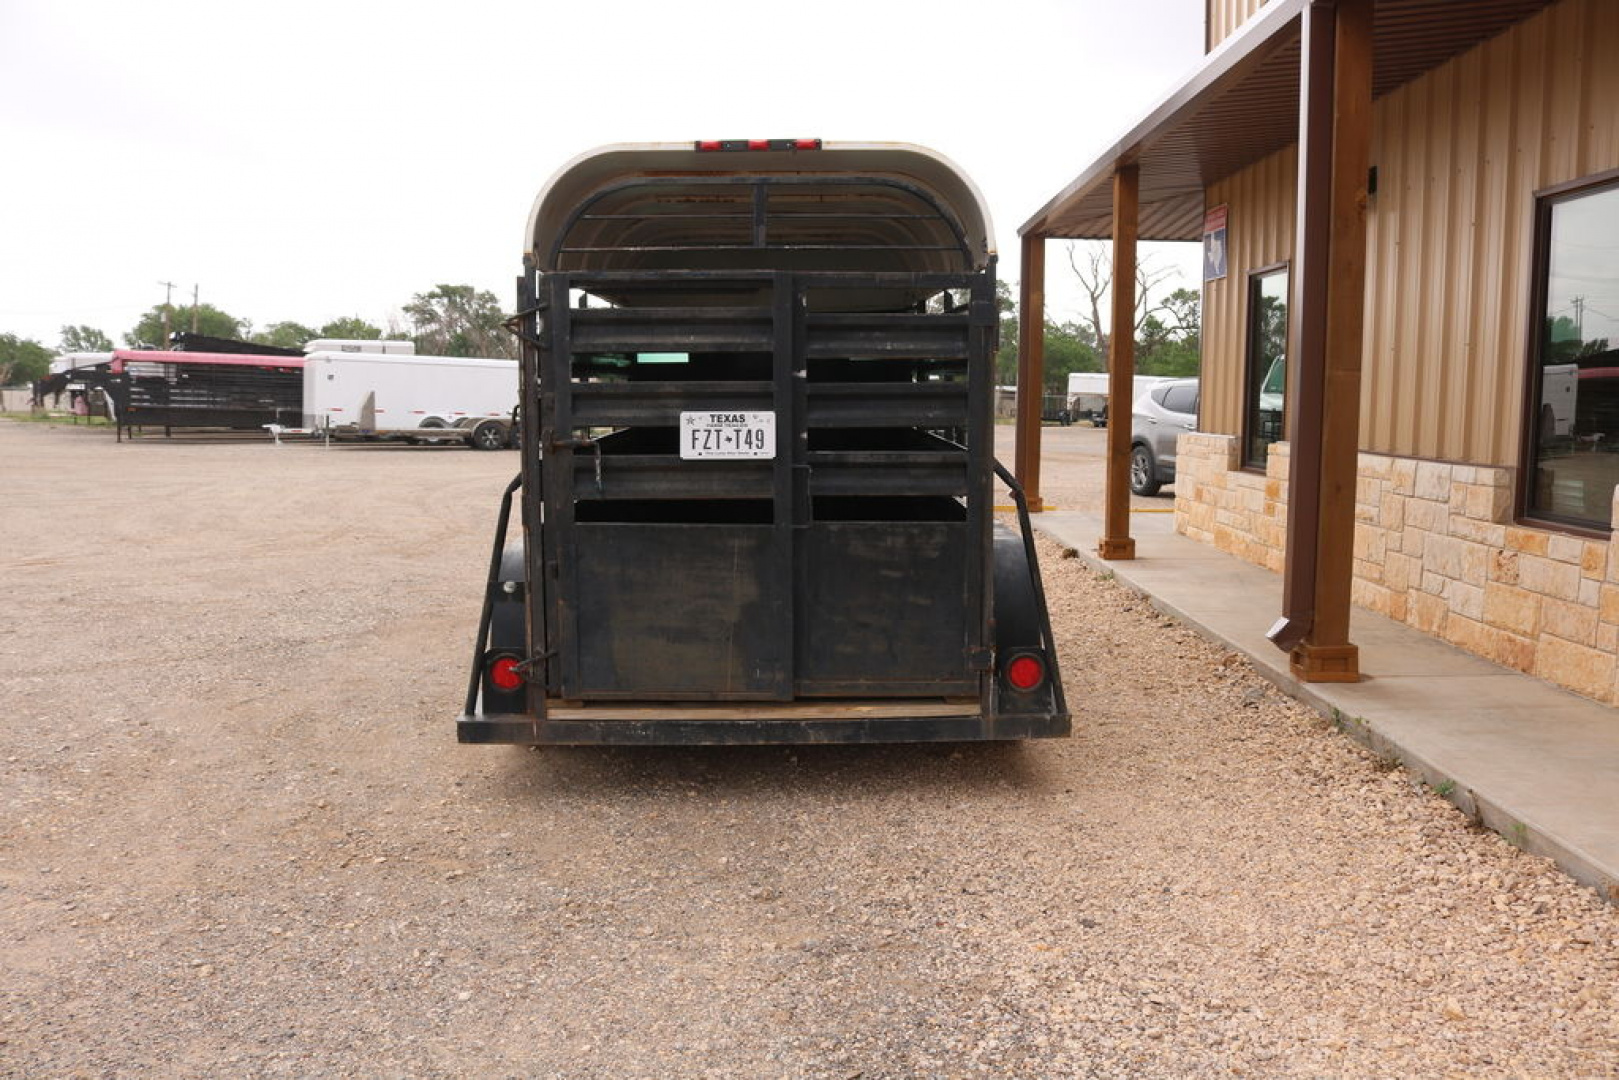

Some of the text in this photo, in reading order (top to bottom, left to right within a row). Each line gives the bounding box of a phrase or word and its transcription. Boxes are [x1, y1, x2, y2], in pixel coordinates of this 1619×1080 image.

[709, 413, 746, 423] TEXAS
[691, 429, 765, 450] FZT T49
